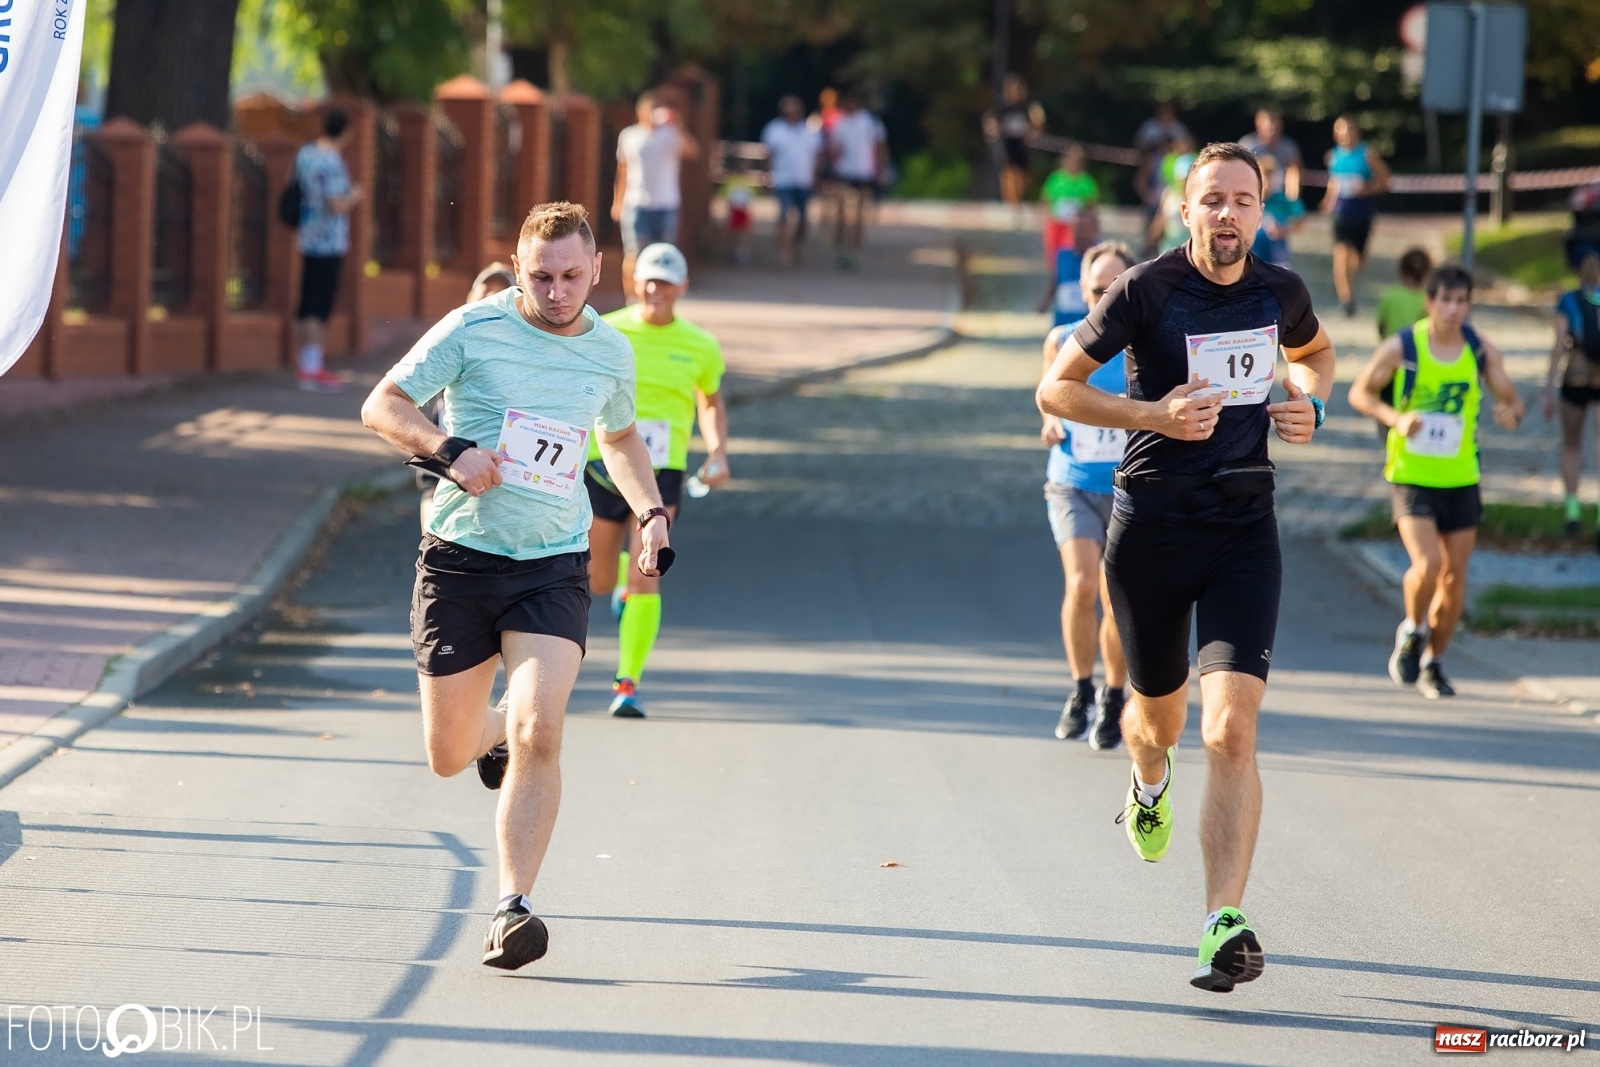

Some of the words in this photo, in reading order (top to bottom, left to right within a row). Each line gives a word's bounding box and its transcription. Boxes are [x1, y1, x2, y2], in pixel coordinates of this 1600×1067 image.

[53, 8, 67, 40] ROK
[1227, 353, 1254, 378] 19
[1097, 428, 1117, 443] 75
[533, 438, 564, 466] 77
